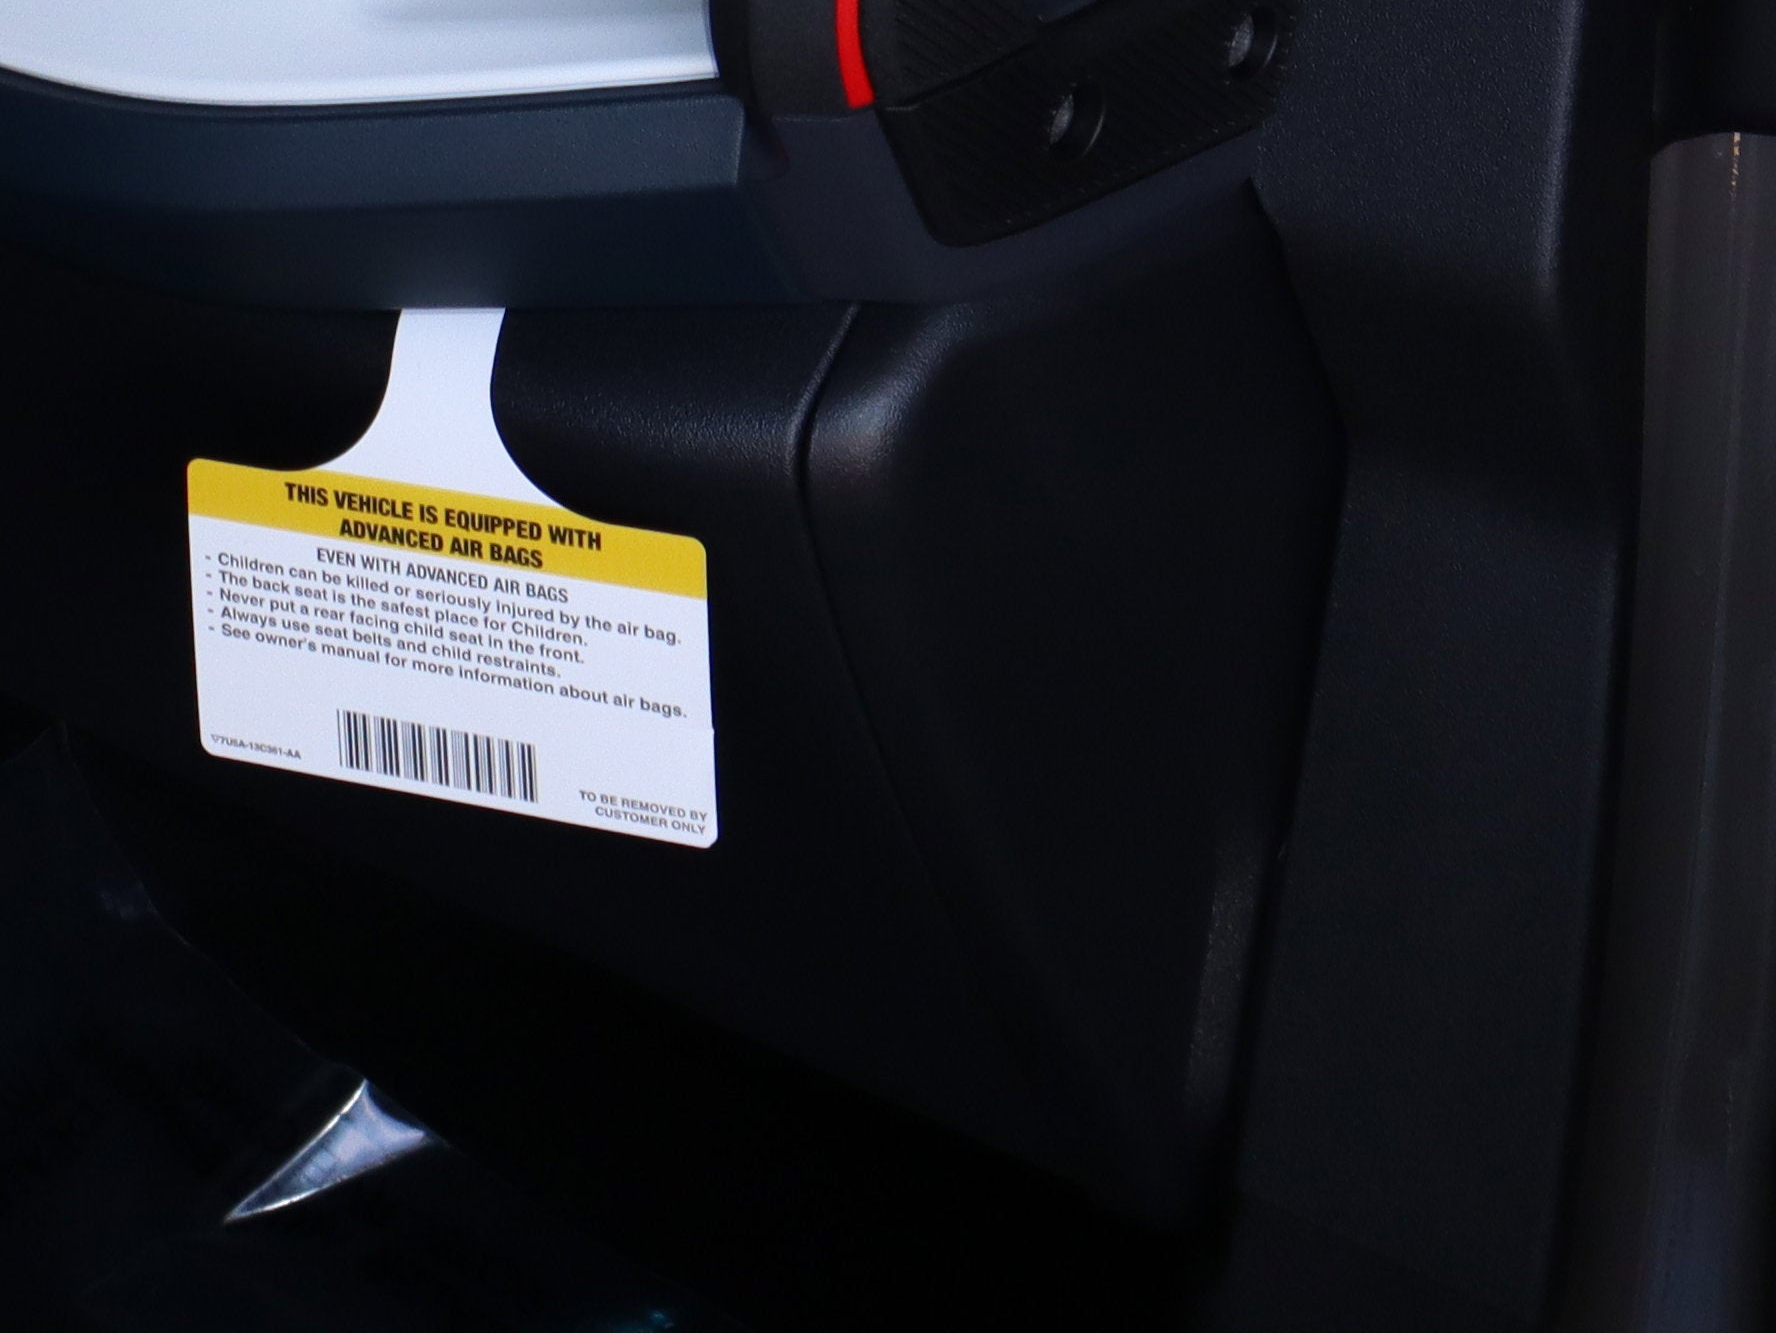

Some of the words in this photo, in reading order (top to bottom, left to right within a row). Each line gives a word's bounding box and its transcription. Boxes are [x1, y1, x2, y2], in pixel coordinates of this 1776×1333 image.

[285, 482, 329, 506] THIS
[334, 490, 413, 520] VEHICLE
[420, 504, 438, 524] IS
[445, 508, 542, 541] EQUIPPED
[549, 525, 601, 551] WITH
[340, 519, 443, 551] ADVANCED
[450, 537, 483, 559] AIR
[490, 543, 543, 568] BAGS
[218, 552, 284, 575] Children
[289, 568, 317, 581] can
[322, 570, 341, 585] be
[347, 575, 389, 594] killed
[394, 586, 411, 598] or
[416, 589, 491, 614] seriously
[497, 600, 554, 622] injured
[560, 611, 580, 629] by
[586, 615, 611, 631] the
[617, 621, 638, 636] air
[644, 625, 681, 646] bag.
[219, 570, 248, 586] The
[253, 574, 290, 594] back
[295, 585, 327, 600] seat
[333, 588, 345, 603] is
[351, 592, 376, 609] the
[381, 598, 430, 619] safest
[435, 608, 478, 628] place
[484, 617, 506, 631] for
[512, 621, 588, 646] Children.
[317, 547, 355, 567] EVEN
[362, 555, 400, 575] WITH
[406, 563, 488, 589] ADVANCED
[494, 577, 520, 595] AIR
[526, 583, 568, 604] BAGS
[220, 588, 264, 608] Never
[270, 599, 295, 614] put
[300, 604, 309, 615] a
[314, 607, 345, 623] rear
[350, 611, 399, 633] facing
[404, 623, 443, 639] child
[450, 630, 483, 646] seat
[489, 636, 503, 649] in
[509, 639, 534, 655] the
[540, 643, 584, 664] front.
[221, 606, 277, 629] Always
[282, 618, 310, 633] use
[315, 623, 348, 640] seat
[353, 631, 392, 648] belts
[397, 638, 427, 654] and
[432, 645, 471, 662] child
[476, 653, 561, 678] restraints.
[221, 624, 250, 640] See
[255, 632, 317, 652] owner's
[321, 642, 381, 663] manual
[385, 653, 406, 668] for
[412, 660, 454, 676] more
[459, 666, 554, 694] information
[560, 686, 608, 704] about
[613, 694, 634, 708] air
[640, 697, 687, 718] bags.
[579, 790, 596, 802] TO
[600, 793, 618, 806] BE
[621, 797, 686, 818] REMOVED
[690, 810, 707, 822] BY
[595, 806, 668, 829] CUSTOMER
[671, 820, 705, 835] ONLY
